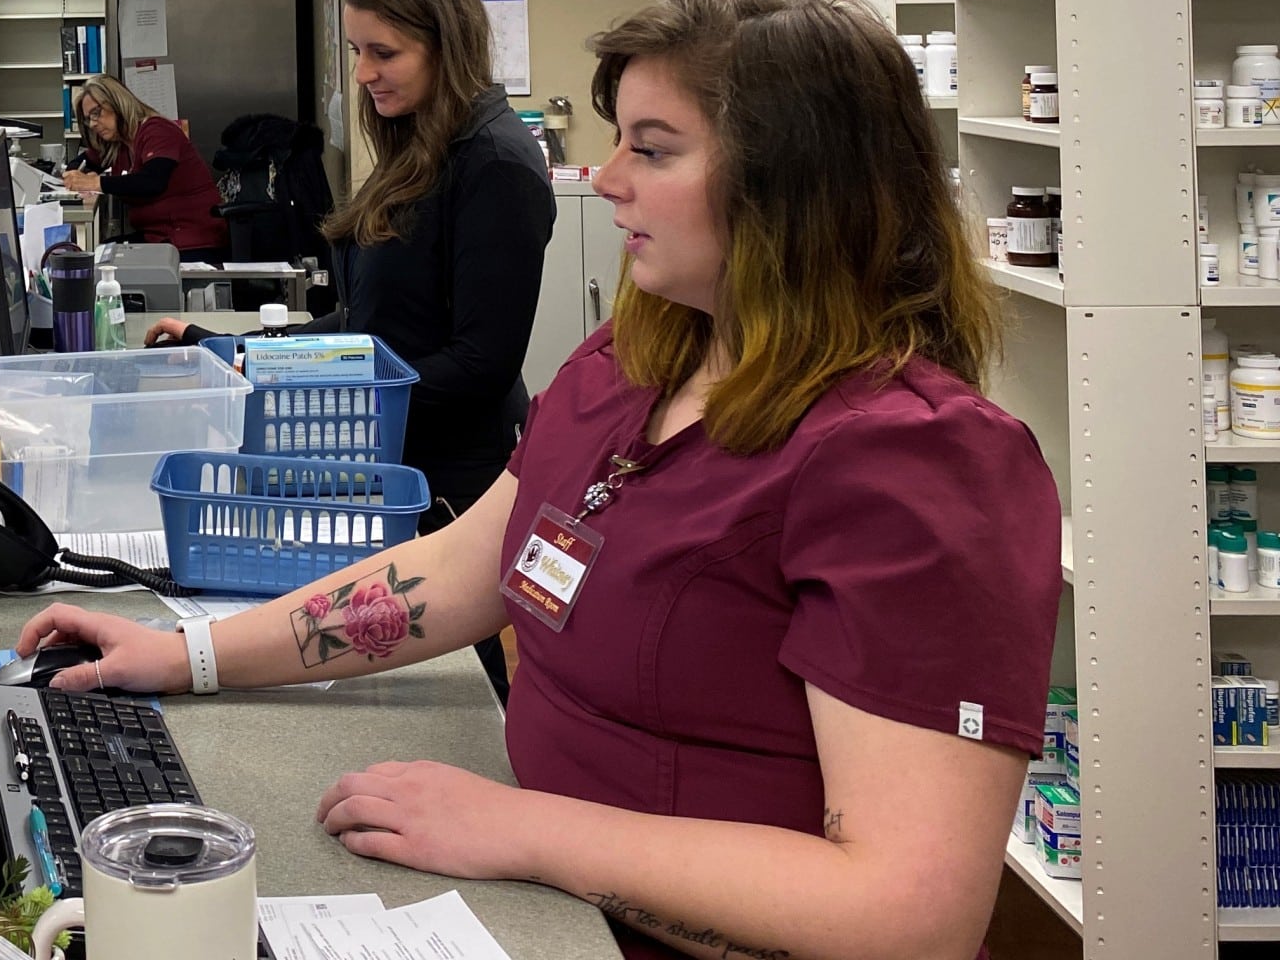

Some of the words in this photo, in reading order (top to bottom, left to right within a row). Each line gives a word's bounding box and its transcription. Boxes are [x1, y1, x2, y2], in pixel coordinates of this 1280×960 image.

[256, 352, 291, 361] Lidocaine
[292, 351, 313, 360] Patch
[314, 351, 325, 360] 5%
[554, 532, 576, 551] Staff
[1247, 688, 1256, 723] Ibuprofen
[666, 919, 724, 948] shall
